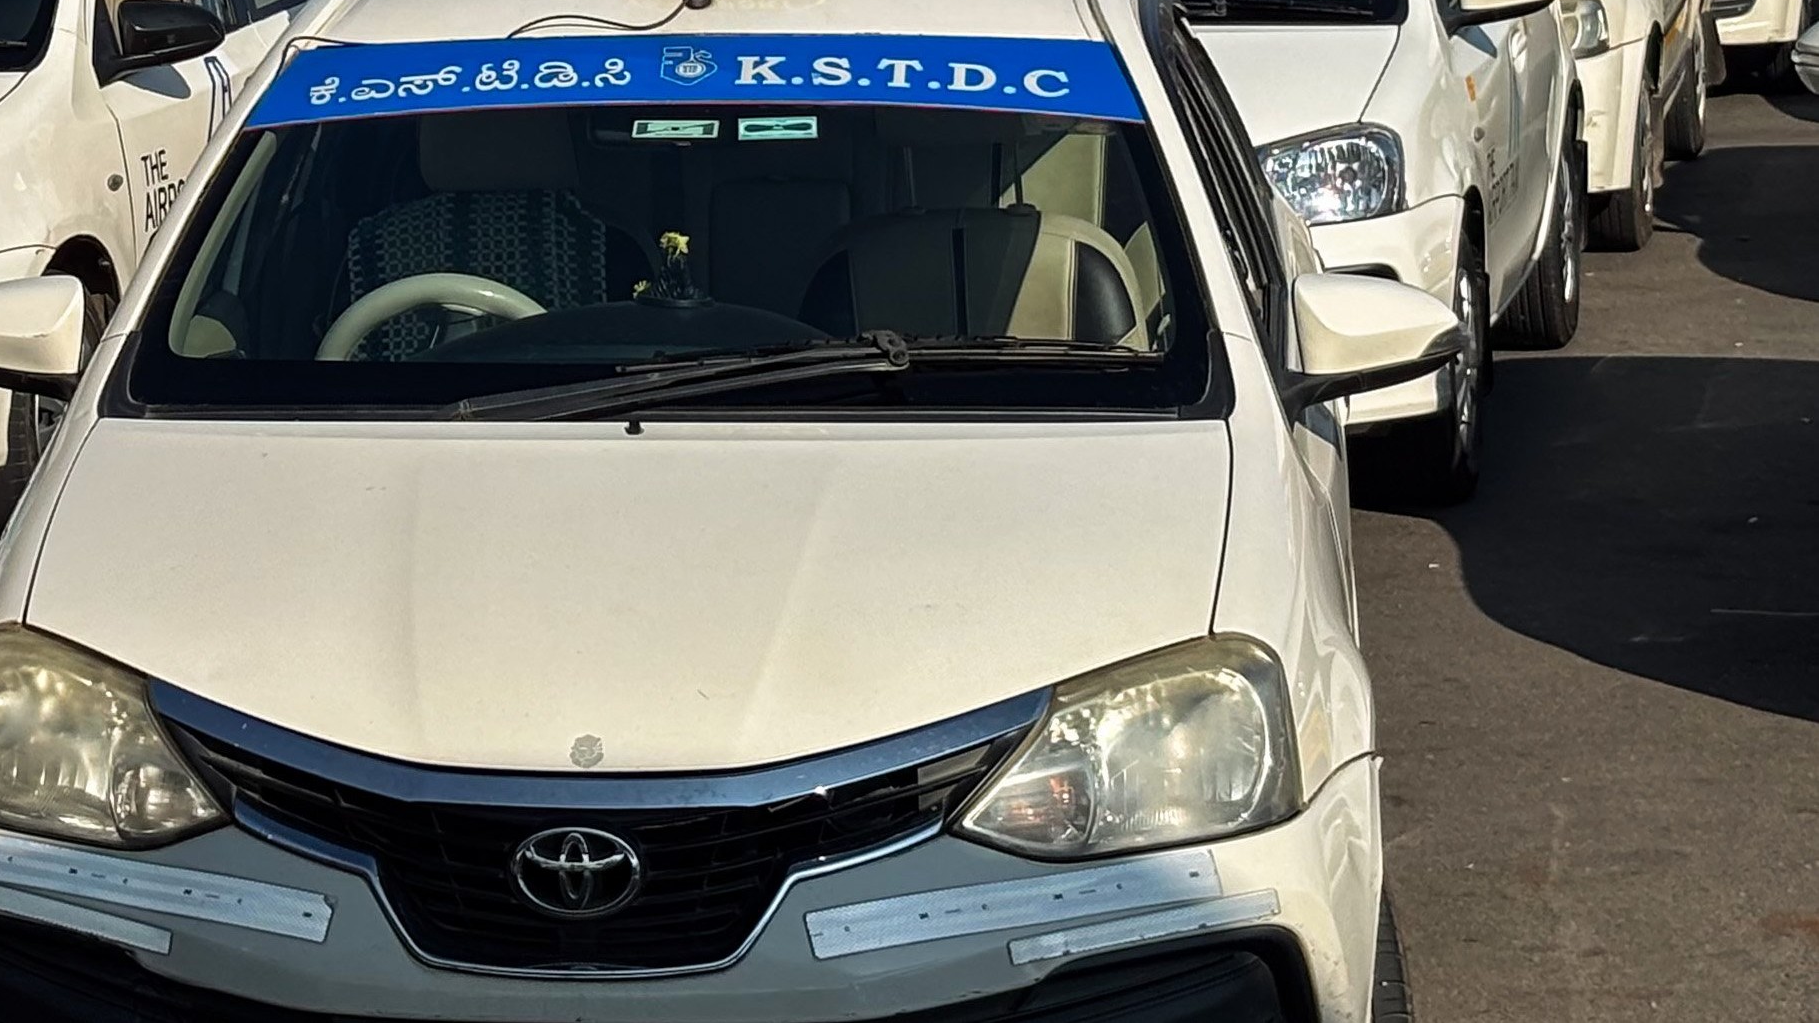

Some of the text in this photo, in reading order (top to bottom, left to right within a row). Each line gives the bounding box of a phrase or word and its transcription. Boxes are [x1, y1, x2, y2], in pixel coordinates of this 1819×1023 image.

[734, 56, 1070, 98] K.S.T.D.C
[141, 148, 170, 187] THE
[144, 178, 185, 233] AIRP
